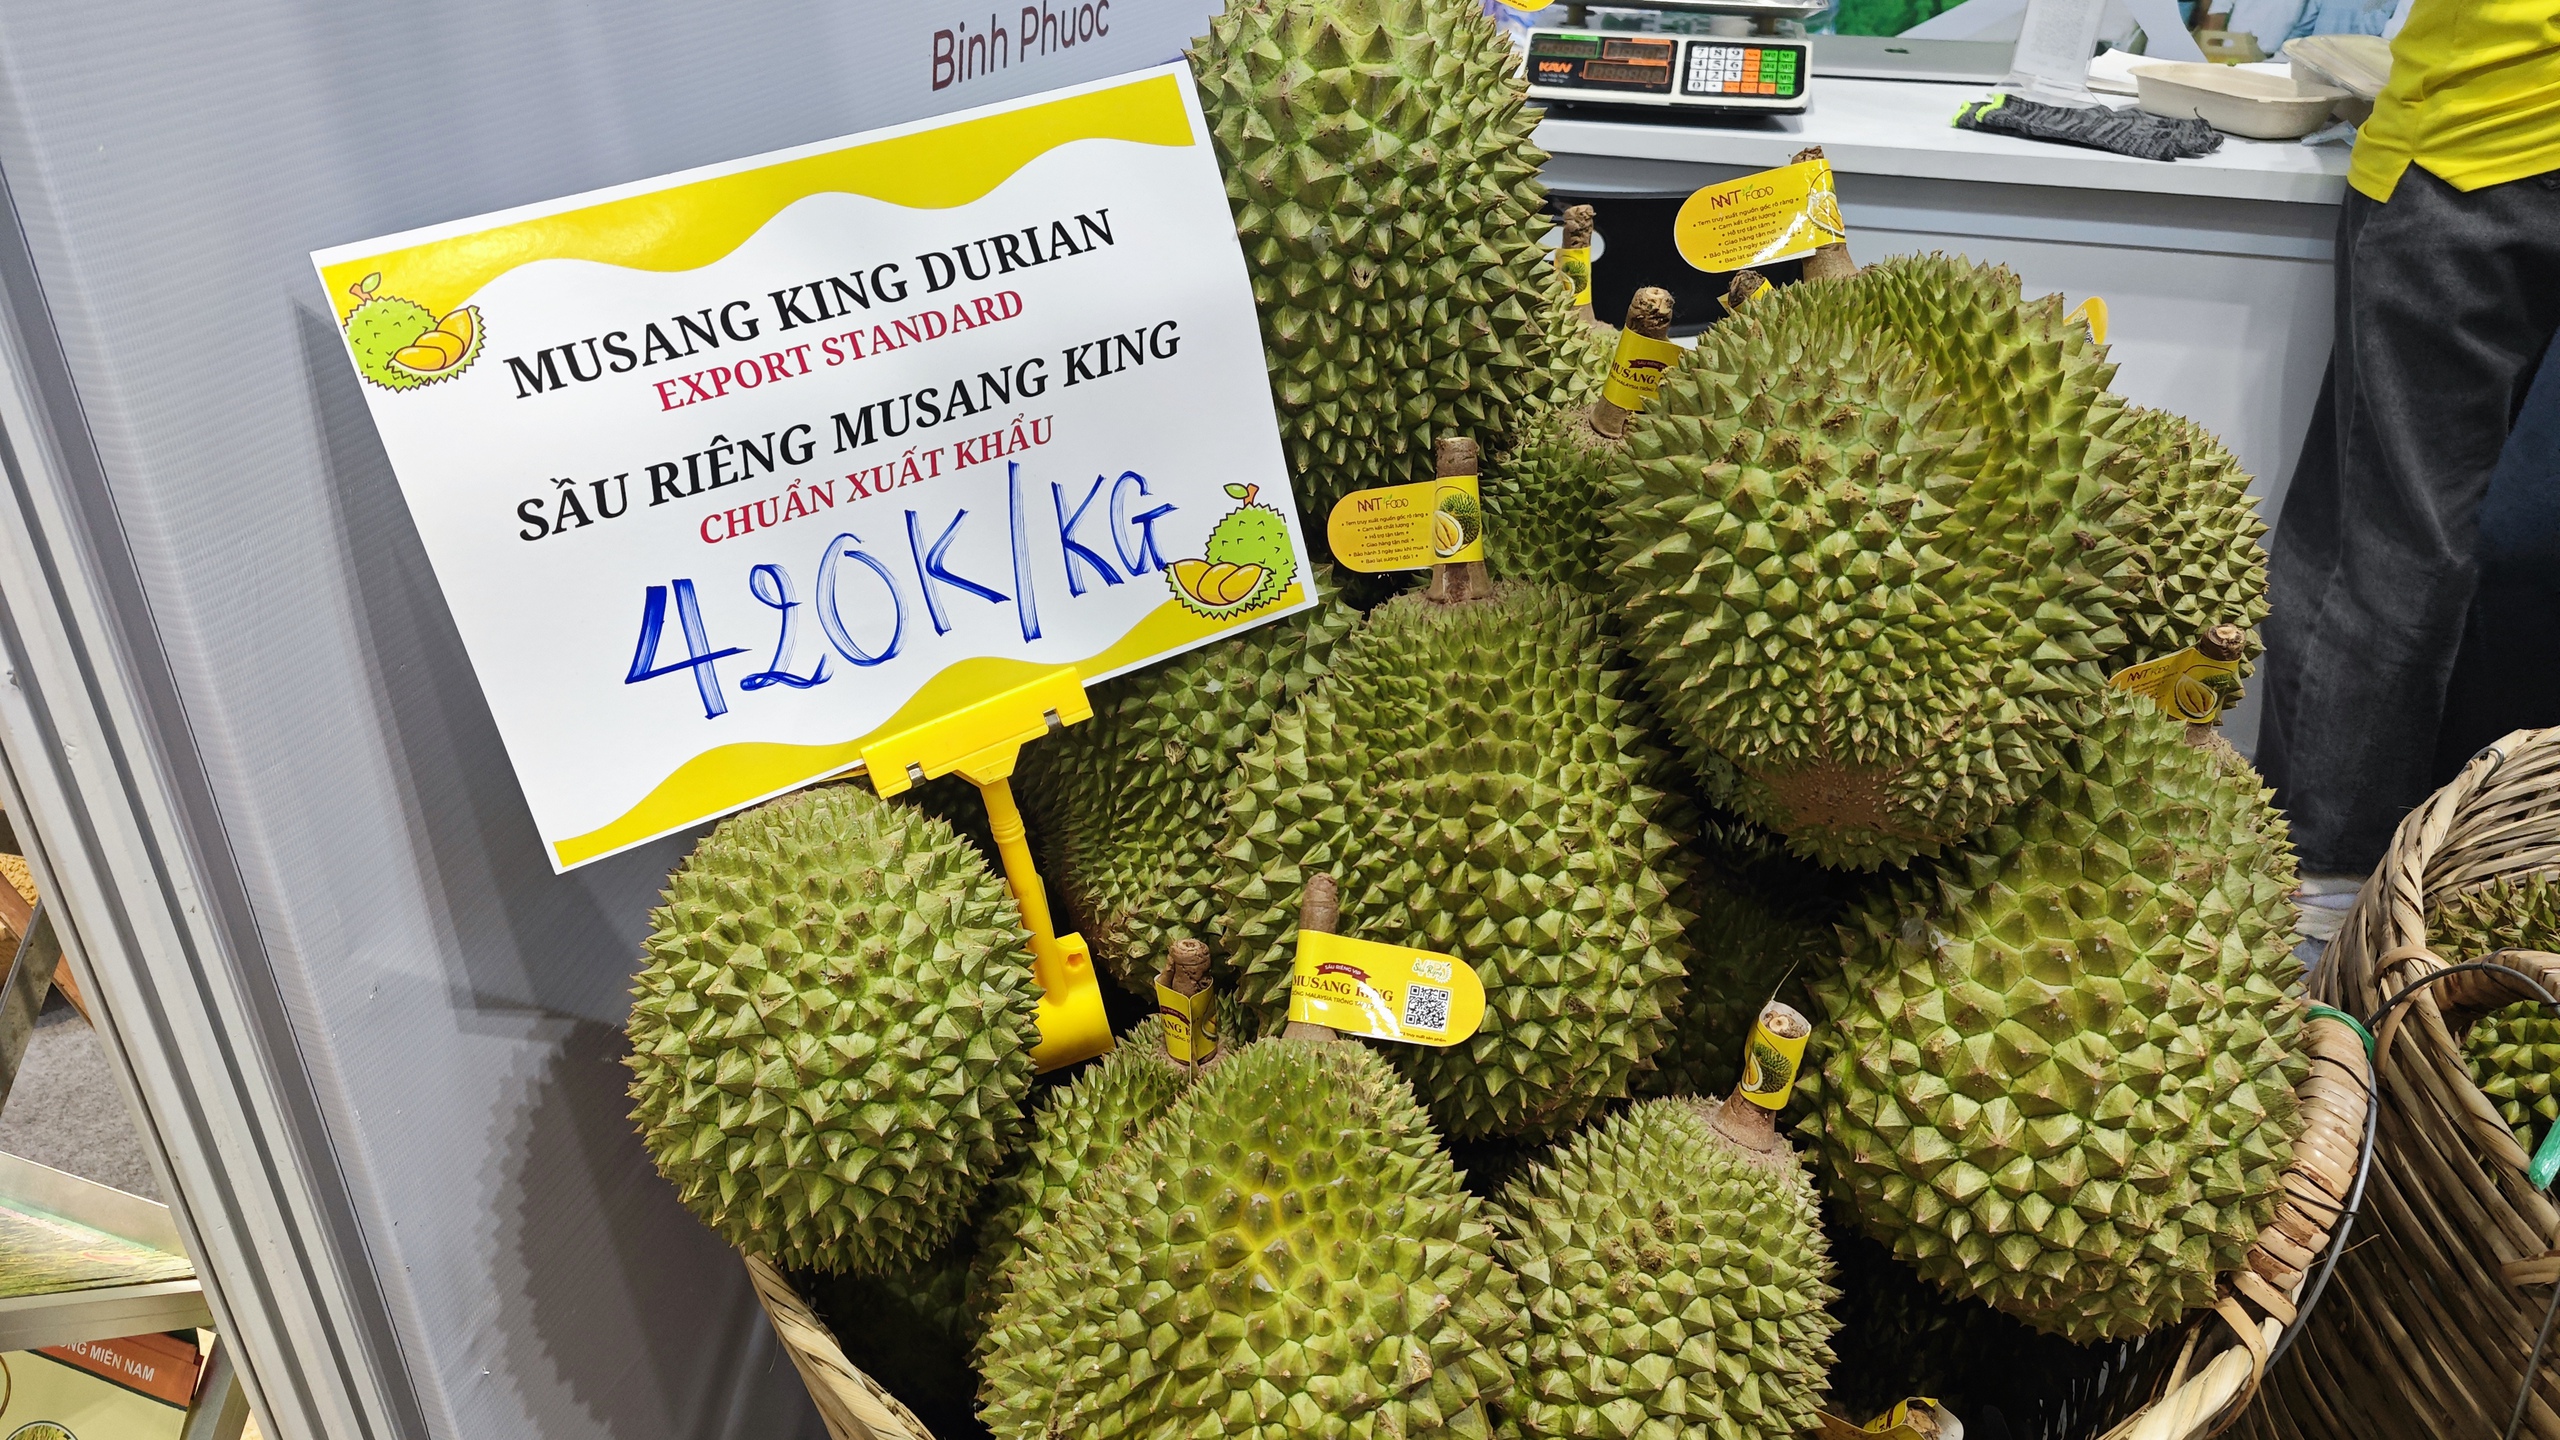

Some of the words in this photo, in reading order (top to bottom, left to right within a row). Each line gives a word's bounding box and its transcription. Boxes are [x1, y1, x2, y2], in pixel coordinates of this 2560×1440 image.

[1692, 81, 1701, 90] 0
[1711, 71, 1719, 80] 2
[1745, 186, 1774, 201] FOOD
[1698, 219, 1711, 227] Tem
[502, 299, 761, 400] MUSANG
[767, 261, 909, 332] KING
[915, 207, 1116, 294] DURIAN
[652, 342, 813, 412] EXPORT
[821, 289, 1024, 367] STANDARD
[516, 472, 630, 542] SẦU
[643, 423, 817, 508] RIÊNG
[829, 356, 1050, 454] MUSANG
[1061, 319, 1182, 388] KING
[699, 477, 836, 544] CHUẨN
[846, 445, 946, 504] XUẤT
[953, 411, 1055, 471] KHẨU
[1385, 497, 1409, 509] FOOD
[624, 459, 1180, 719] 420K/KG
[1292, 974, 1351, 995] MUSANG
[1304, 992, 1333, 1002] MALAYSIA
[123, 1358, 155, 1382] NAM
